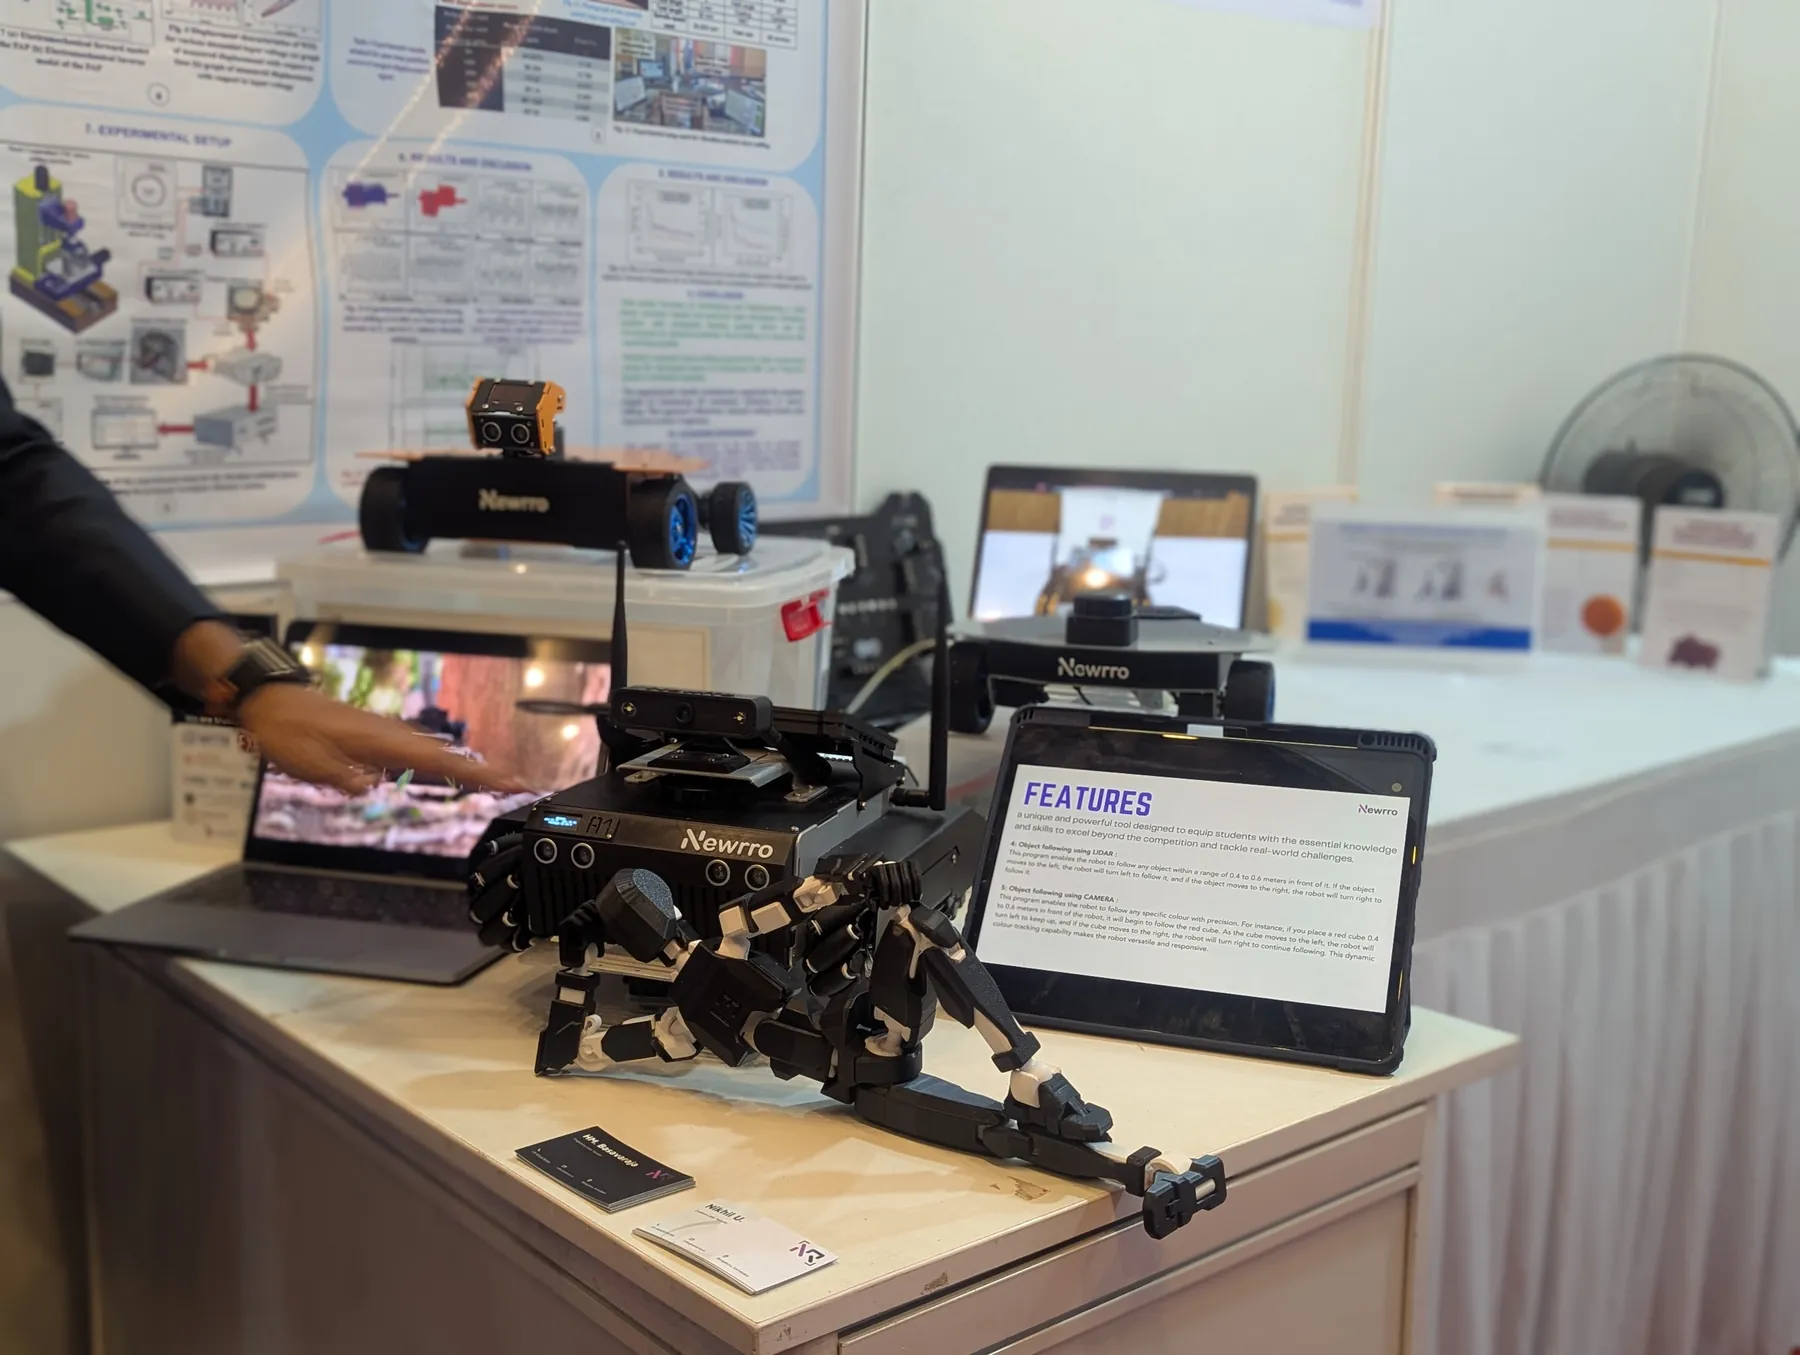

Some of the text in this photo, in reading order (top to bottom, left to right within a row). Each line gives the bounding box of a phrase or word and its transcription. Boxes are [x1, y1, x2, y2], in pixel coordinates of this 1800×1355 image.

[478, 489, 550, 513] Newrro
[1057, 657, 1129, 680] Newrro
[1023, 781, 1153, 817] FEATURES
[1358, 803, 1398, 816] Newrro
[680, 828, 774, 859] Newrro
[1014, 822, 1354, 864] and skills to excel beyond the competition and tackle real-world challenges.
[1017, 841, 1113, 856] Object following using LIDAR
[1023, 810, 1053, 822] unique
[1054, 813, 1071, 822] and
[1072, 815, 1112, 827] powerful
[1113, 819, 1131, 828] tool
[1132, 821, 1174, 834] designed
[1176, 825, 1186, 834] to
[1187, 826, 1214, 837] equip
[1215, 829, 1257, 840] students
[1258, 833, 1280, 843] with
[1281, 835, 1297, 844] the
[1298, 837, 1341, 849] essential
[1343, 841, 1397, 855] knowledge
[1073, 865, 1092, 873] robot
[1105, 868, 1119, 876] turn
[1141, 872, 1161, 880] follow
[1170, 875, 1184, 883] and
[1190, 877, 1202, 885] the
[1203, 879, 1225, 888] object
[1258, 884, 1271, 892] the
[1304, 889, 1325, 898] robot
[1339, 893, 1354, 901] turn
[1355, 895, 1372, 903] right
[1088, 857, 1107, 865] robot
[1115, 860, 1136, 868] follow
[1149, 864, 1171, 872] object
[1172, 866, 1193, 874] within
[1199, 869, 1219, 877] range
[1262, 875, 1287, 884] meters
[1296, 879, 1313, 887] front
[1352, 884, 1375, 894] object
[1007, 885, 1115, 902] Object following using CAMERA
[992, 920, 1040, 932] colour-tracking
[1040, 926, 1072, 936] capability
[1072, 930, 1094, 938] makes
[1095, 932, 1106, 940] the
[1107, 934, 1126, 942] robot
[1127, 936, 1155, 945] versatile
[1156, 939, 1170, 947] and
[1079, 902, 1098, 910] robot
[1107, 905, 1128, 914] follow
[1128, 908, 1141, 916] any
[1141, 909, 1167, 919] specific
[1167, 912, 1189, 920] colour
[1240, 920, 1253, 928] For
[1307, 928, 1326, 937] place
[1347, 932, 1365, 940] cube
[1367, 934, 1378, 942] 0.4
[1124, 916, 1144, 925] begin
[1154, 920, 1175, 928] follow
[1175, 922, 1187, 930] the
[1245, 930, 1263, 938] cube
[1264, 933, 1287, 941] moves
[1297, 936, 1310, 944] the
[1327, 939, 1339, 947] the
[1340, 941, 1360, 950] robot
[1362, 943, 1374, 951] will
[1090, 922, 1107, 930] cube
[1107, 925, 1129, 933] moves
[1184, 933, 1204, 941] robot
[1204, 935, 1216, 943] will
[1217, 937, 1232, 945] turn
[1233, 939, 1250, 948] right
[1260, 942, 1291, 952] continue
[1328, 950, 1343, 958] This
[1344, 952, 1374, 962] dynamic
[705, 1203, 736, 1217] Nikhil
